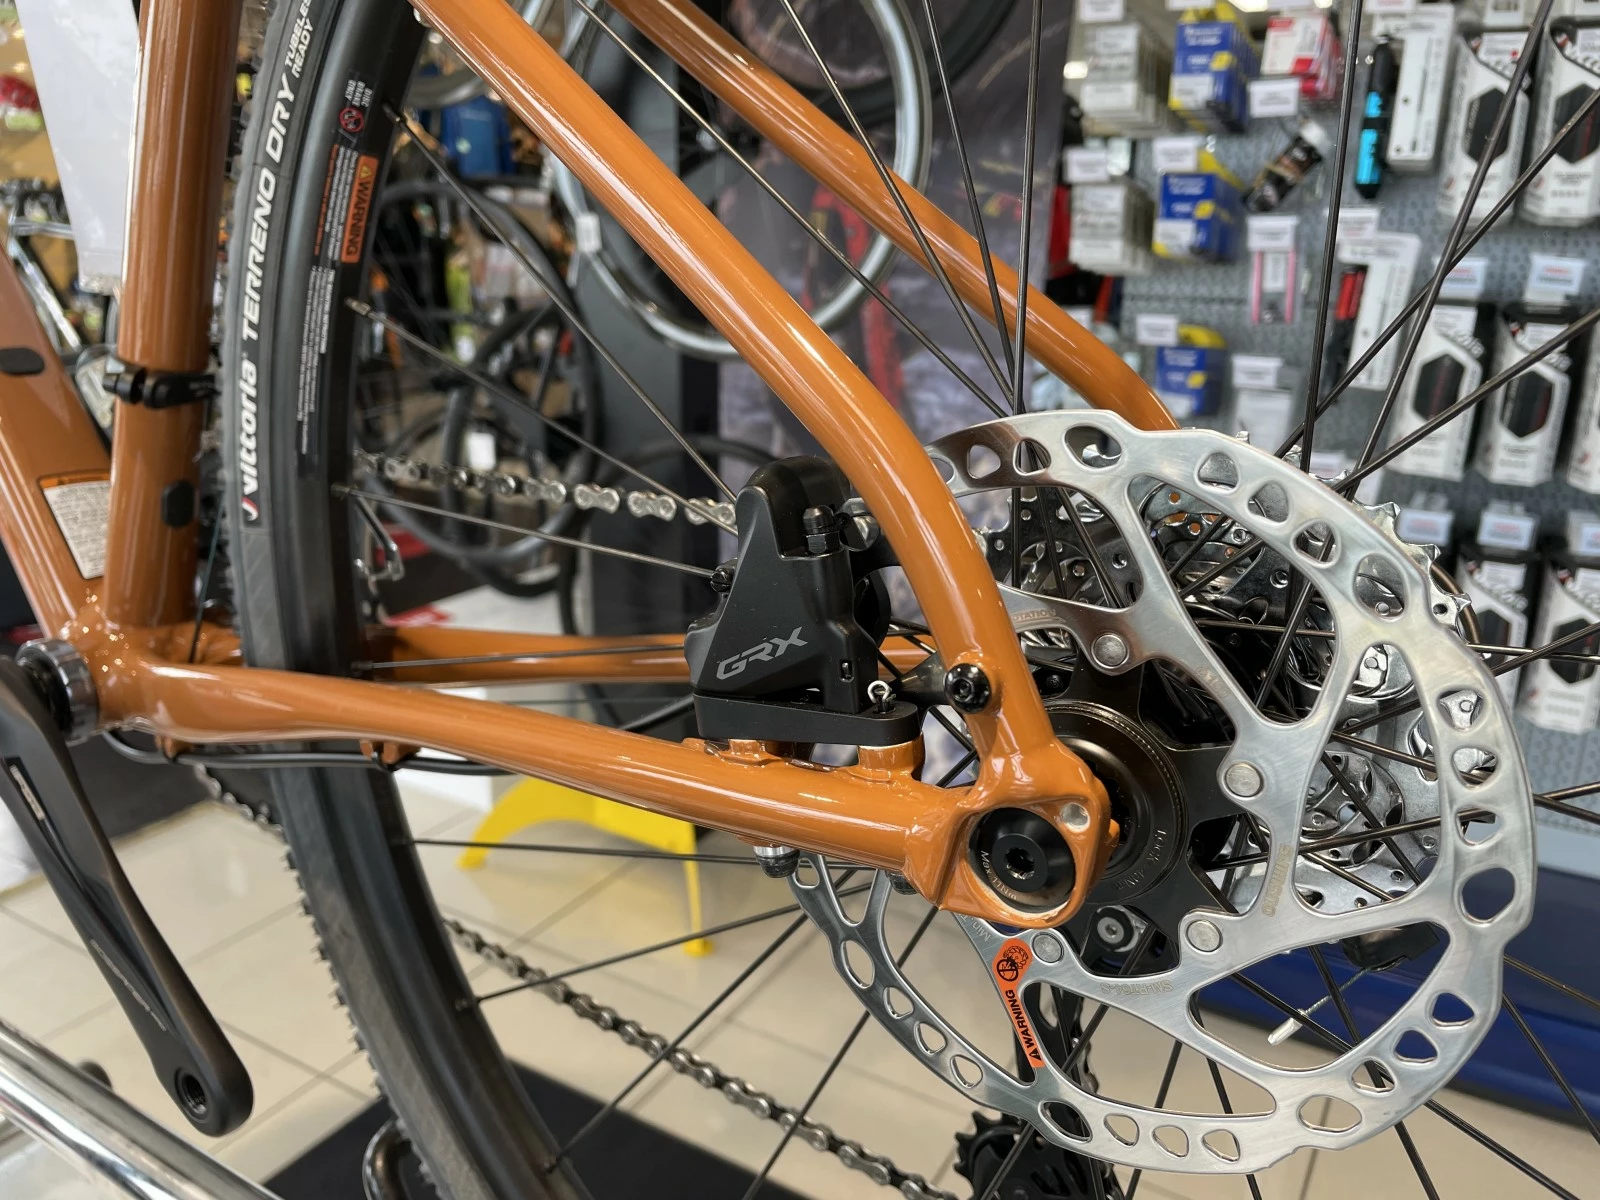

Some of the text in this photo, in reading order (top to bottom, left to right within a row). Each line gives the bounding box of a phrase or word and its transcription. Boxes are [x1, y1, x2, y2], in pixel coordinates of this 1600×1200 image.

[291, 18, 314, 79] READY
[243, 167, 276, 341] TERRENO
[266, 72, 294, 163] DRY
[346, 180, 372, 256] WARNING
[1009, 608, 1058, 622] OTATION
[716, 626, 808, 680] GRX
[980, 850, 994, 875] Max
[1146, 829, 1167, 862] LOCK
[1004, 988, 1040, 1050] WARNING
